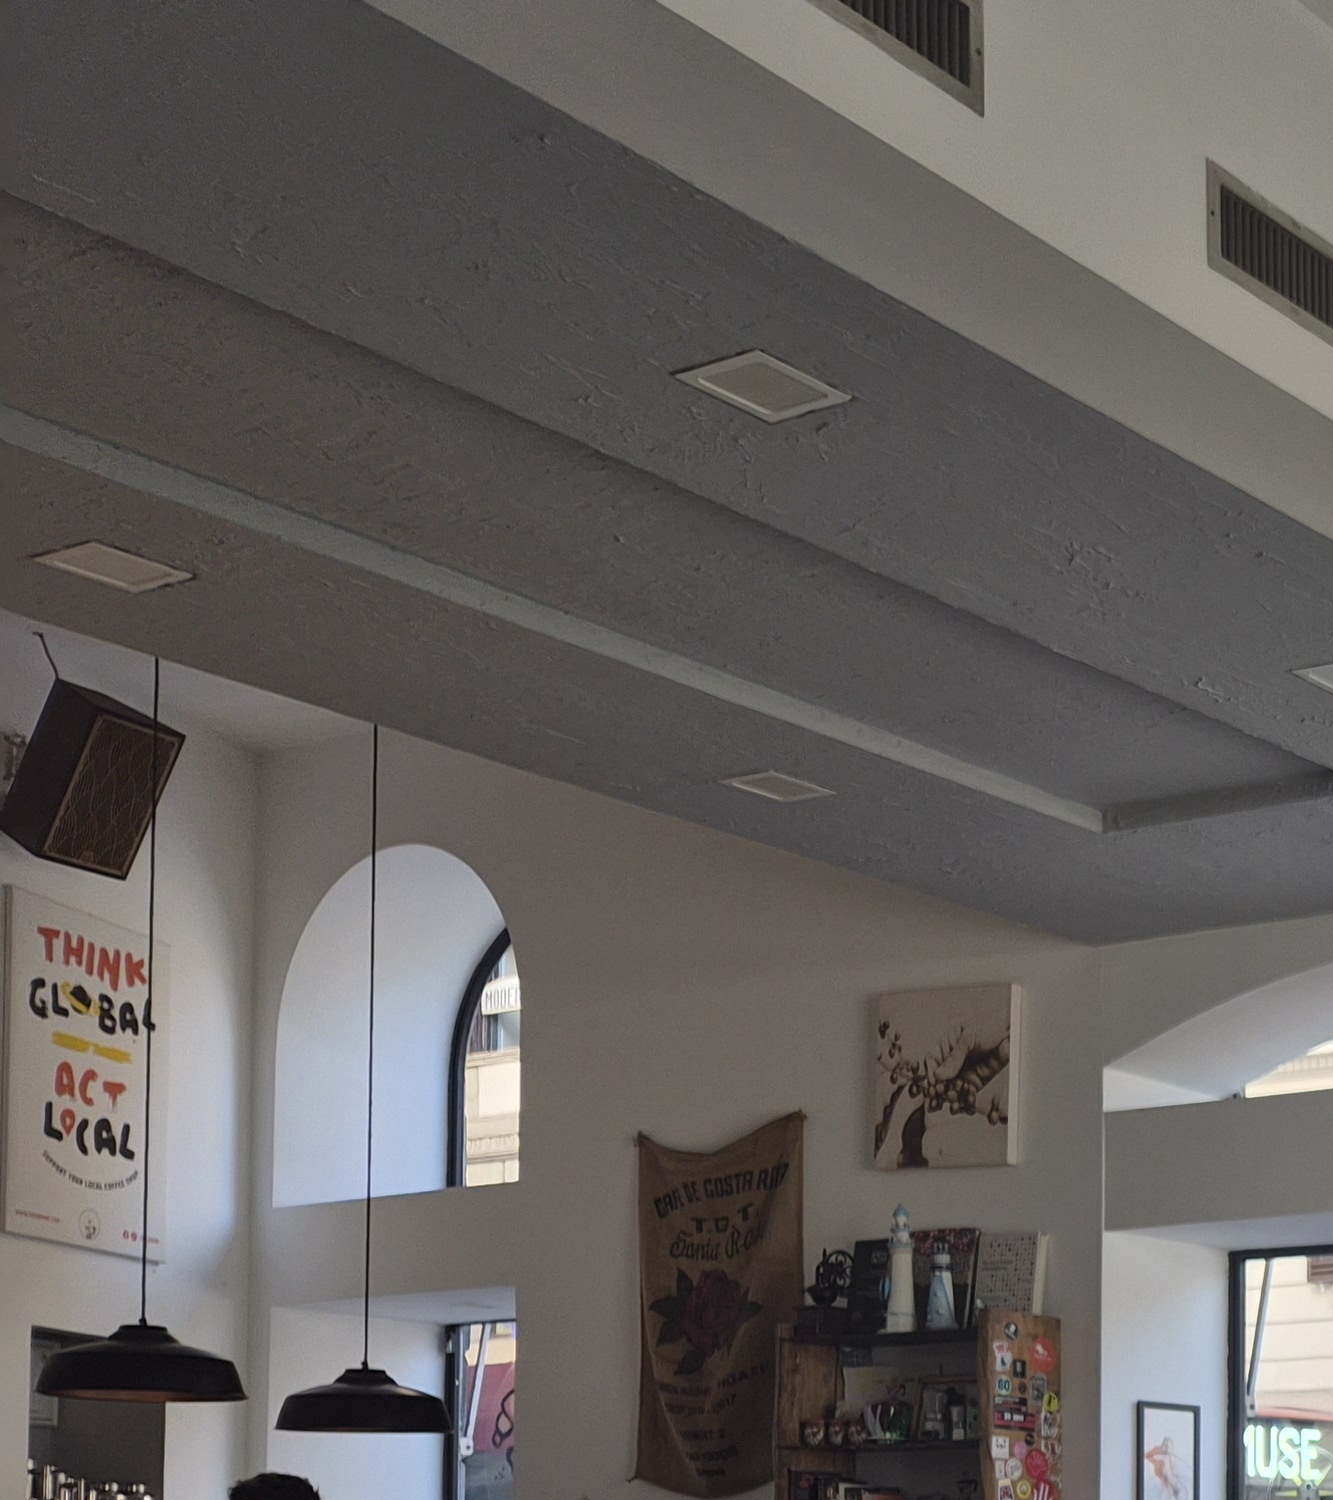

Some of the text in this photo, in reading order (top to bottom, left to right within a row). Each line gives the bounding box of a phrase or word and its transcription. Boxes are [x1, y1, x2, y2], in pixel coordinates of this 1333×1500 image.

[37, 925, 147, 992] THINK
[55, 1060, 126, 1113] ACT
[43, 1101, 135, 1161] LOCAL
[703, 1171, 754, 1199] COSTA
